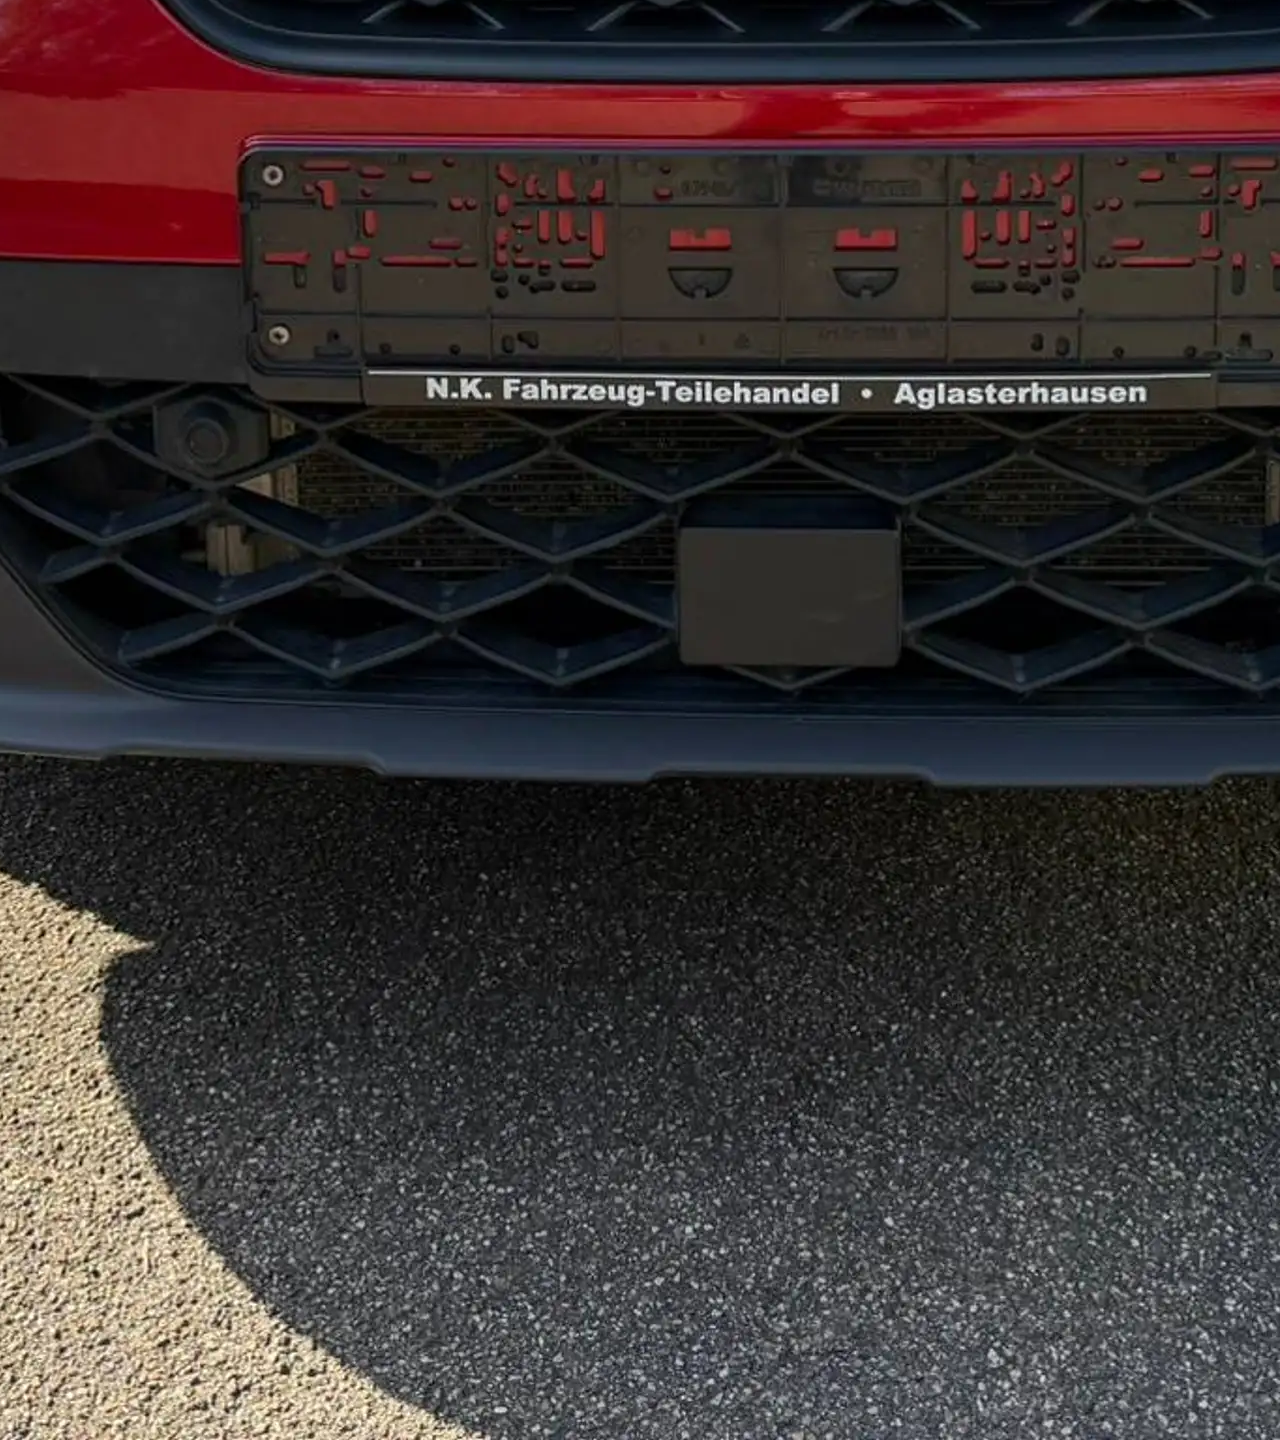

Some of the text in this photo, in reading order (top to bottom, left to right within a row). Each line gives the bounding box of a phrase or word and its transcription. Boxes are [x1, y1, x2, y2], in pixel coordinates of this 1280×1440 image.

[426, 377, 1147, 409] N.K. Fahrzeug-Teilehandel Aglasterhausen
